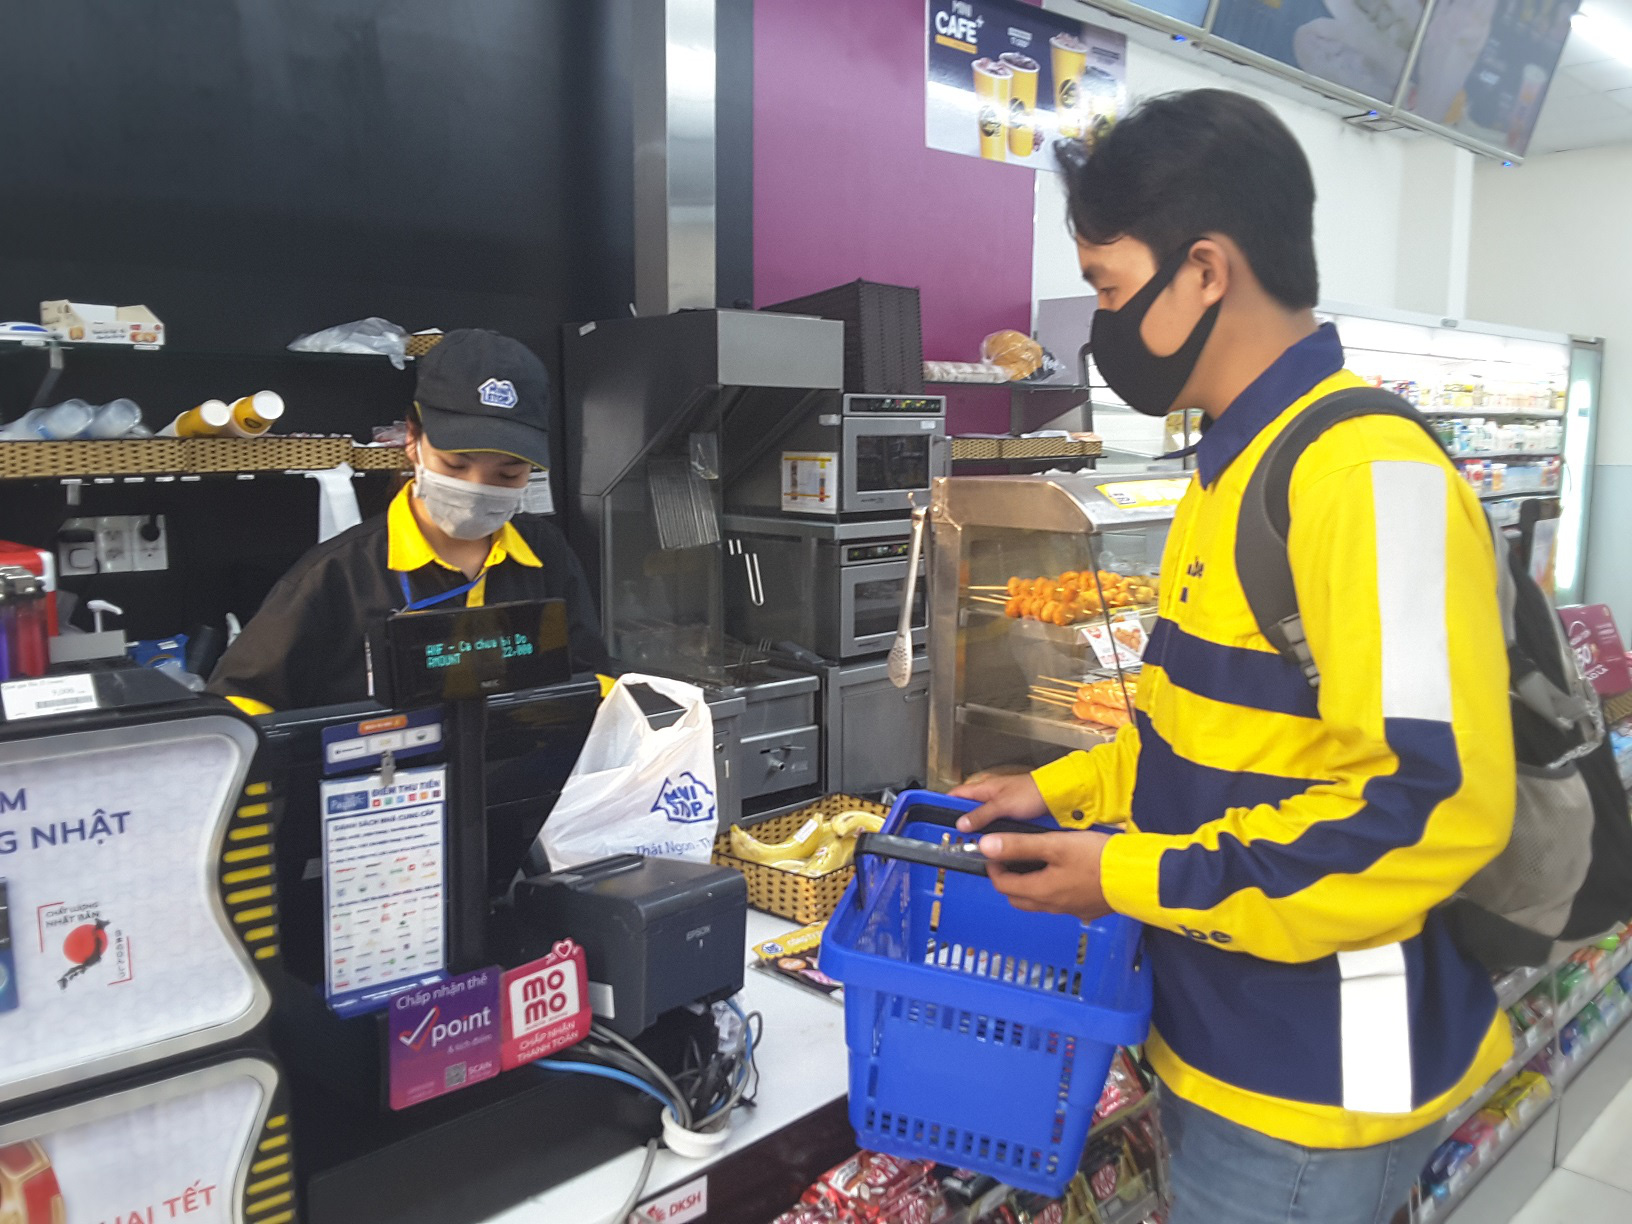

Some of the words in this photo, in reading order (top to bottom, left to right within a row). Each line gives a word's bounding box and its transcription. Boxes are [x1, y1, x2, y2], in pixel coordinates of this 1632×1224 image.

[31, 808, 132, 850] NHẬT
[1178, 924, 1233, 944] be
[396, 989, 432, 1011] Chấp
[432, 981, 464, 999] nhận
[163, 1179, 216, 1218] TẾT
[669, 1190, 702, 1217] DKSH
